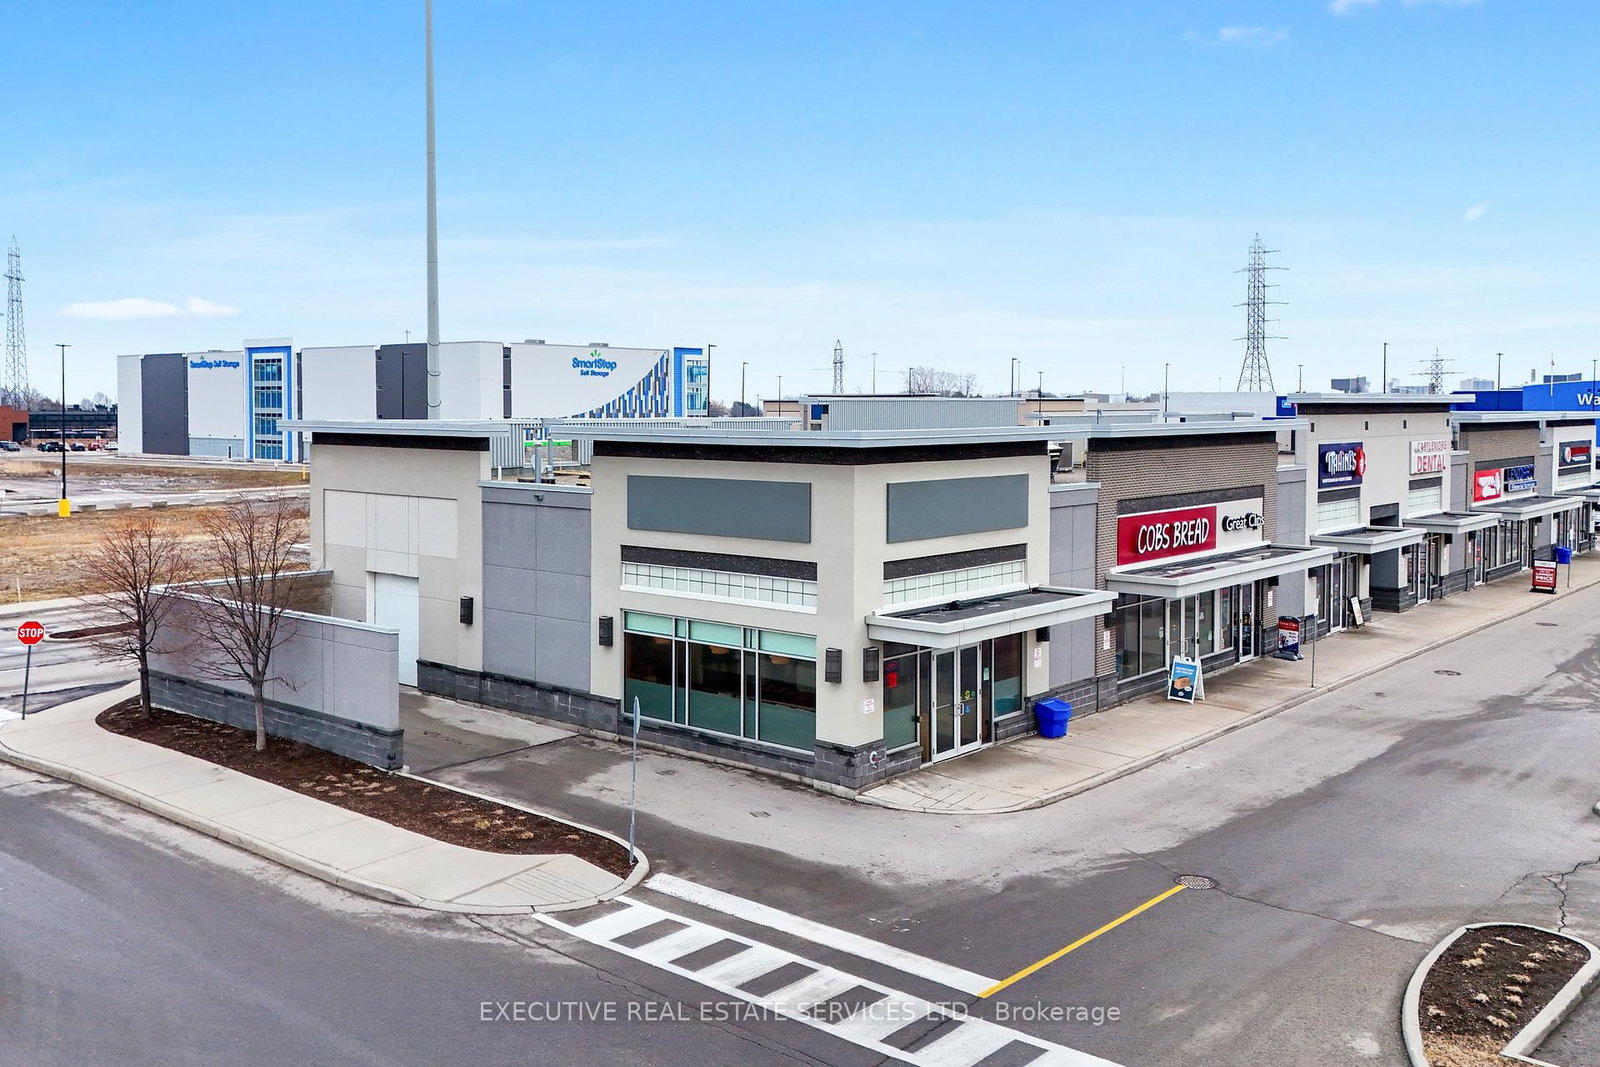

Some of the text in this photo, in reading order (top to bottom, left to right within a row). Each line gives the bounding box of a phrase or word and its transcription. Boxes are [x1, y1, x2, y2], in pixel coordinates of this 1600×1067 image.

[572, 357, 617, 371] SmartStop
[1417, 454, 1446, 472] DENTAL
[1224, 512, 1265, 531] Great Clips
[1137, 518, 1210, 554] COBS BREAD
[19, 628, 43, 638] STOP
